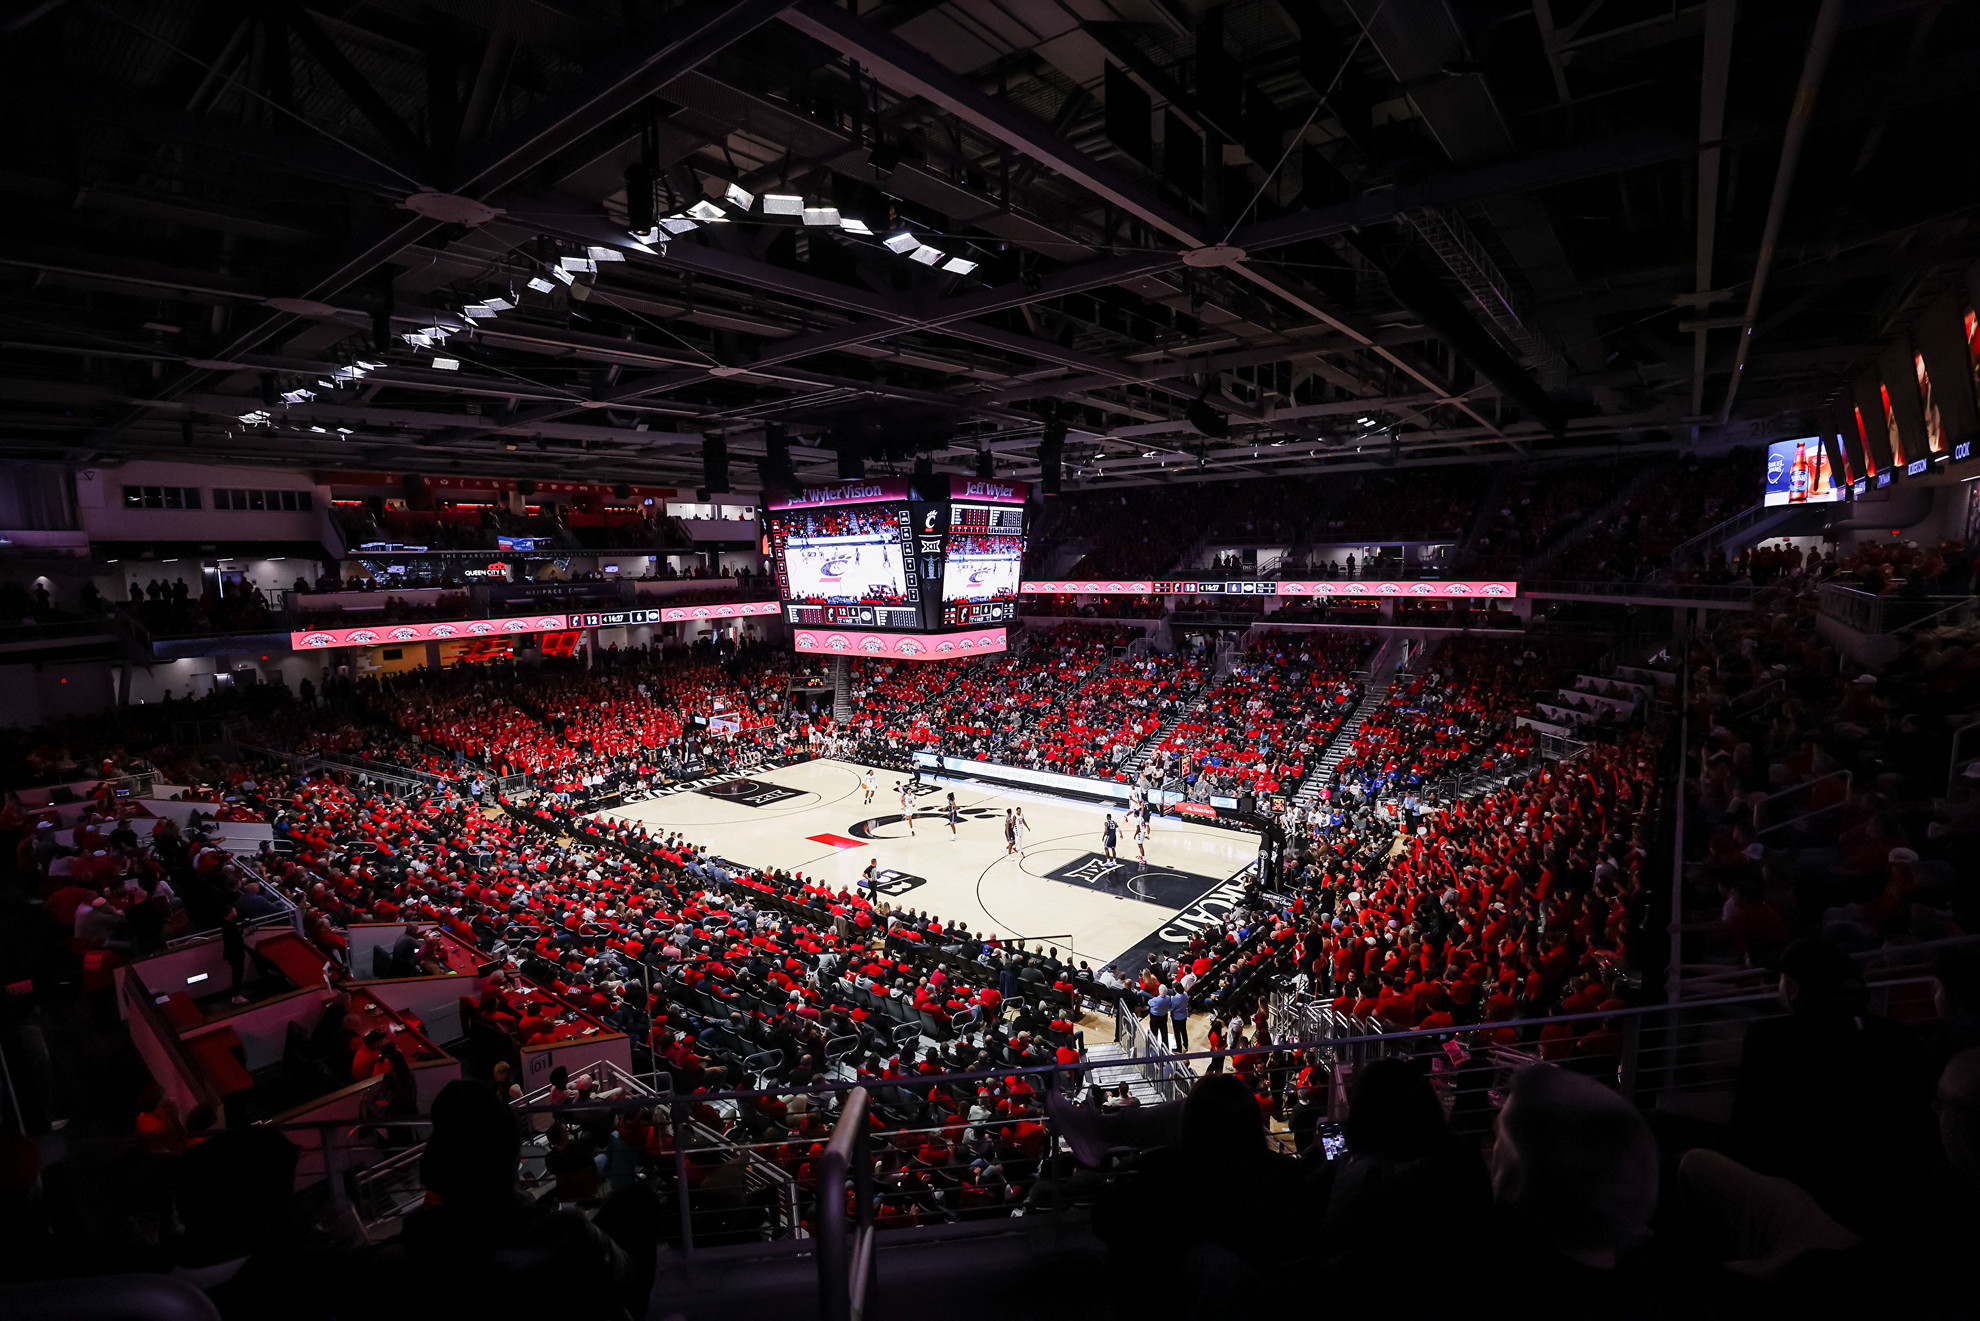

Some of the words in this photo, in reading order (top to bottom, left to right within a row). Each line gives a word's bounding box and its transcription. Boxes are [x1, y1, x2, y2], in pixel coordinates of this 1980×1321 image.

[1954, 440, 1971, 460] COOK
[965, 481, 986, 496] Jeff
[986, 483, 1014, 500] Wyler
[464, 569, 487, 577] QUEEN
[525, 588, 567, 596] MEDPACE
[1186, 584, 1196, 592] 12
[838, 607, 846, 616] 12
[850, 607, 856, 616] 6
[972, 606, 980, 615] 12
[984, 605, 988, 613] 6
[586, 616, 598, 625] 12
[636, 612, 642, 621] 6
[622, 762, 782, 804] CINCINNATI
[983, 766, 1001, 775] Proud
[1001, 769, 1025, 778] partner
[1034, 774, 1045, 782] the
[1057, 777, 1088, 789] Bearcats
[534, 1059, 546, 1073] 01
